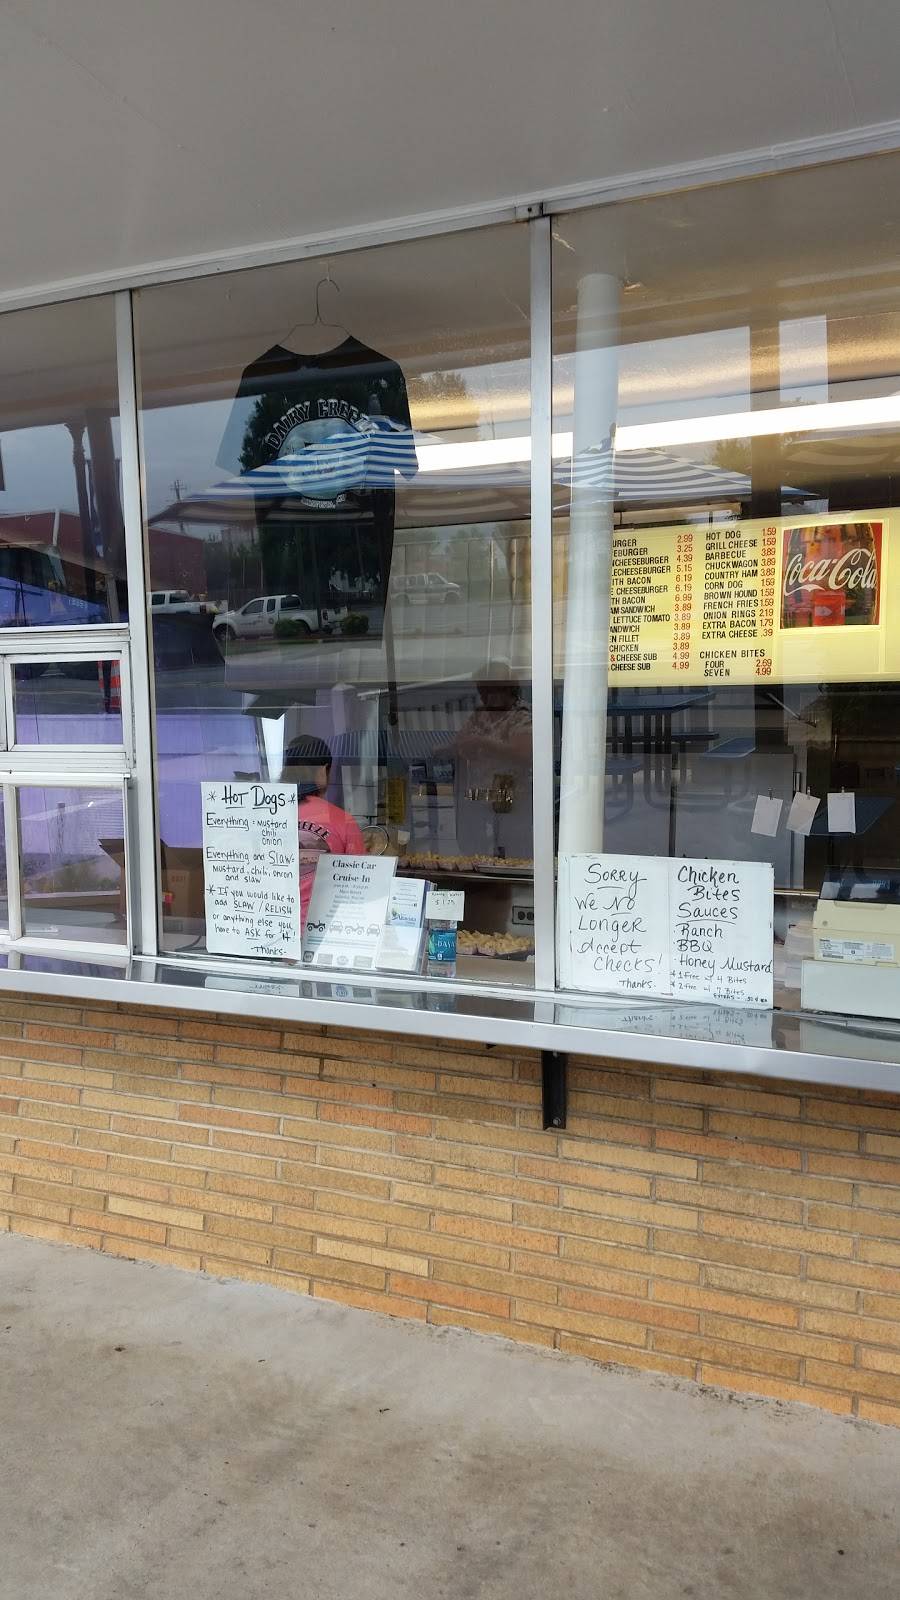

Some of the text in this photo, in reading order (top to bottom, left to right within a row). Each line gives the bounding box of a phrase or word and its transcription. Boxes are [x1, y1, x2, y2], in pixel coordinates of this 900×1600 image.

[265, 401, 310, 449] DAIRY
[677, 534, 693, 543] 2.99
[706, 532, 721, 540] HOT
[706, 542, 728, 550] GRILL
[728, 539, 758, 548] CHEESE
[705, 550, 746, 560] BARBECUE
[705, 571, 739, 580] COUNTRY
[784, 548, 877, 596] Coca-Cola
[616, 585, 668, 595] CHEESEBURGER
[705, 582, 724, 590] CORN
[704, 592, 732, 600] BROWN
[734, 589, 758, 598] HOUND
[621, 605, 655, 613] SANDWICH
[704, 601, 733, 610] FRENCH
[737, 600, 759, 608] FRIES
[644, 614, 670, 622] TOMATO
[704, 611, 727, 619] ONION
[732, 610, 756, 618] RINGS
[702, 621, 726, 630] EXTRA
[730, 620, 756, 628] BACON
[702, 631, 726, 639] EXTRA
[729, 629, 758, 638] CHEESE
[609, 644, 639, 652] CHICKEN
[741, 649, 766, 657] BITES
[250, 785, 286, 815] Dogs
[206, 847, 249, 864] Everything
[333, 860, 360, 869] Classic
[333, 873, 359, 882] Cruise
[678, 866, 739, 888] Chicken
[231, 890, 244, 901] you
[247, 891, 268, 899] would
[272, 893, 284, 902] like
[687, 885, 740, 901] Bites
[575, 893, 598, 910] We
[677, 902, 739, 919] Sauces
[223, 915, 254, 928] anything
[258, 919, 272, 927] else
[278, 922, 293, 933] you
[245, 928, 260, 937] ASK
[265, 930, 274, 938] for
[676, 923, 723, 941] Ranch
[677, 939, 714, 953] BBQ
[680, 954, 772, 977] Honey Mustard
